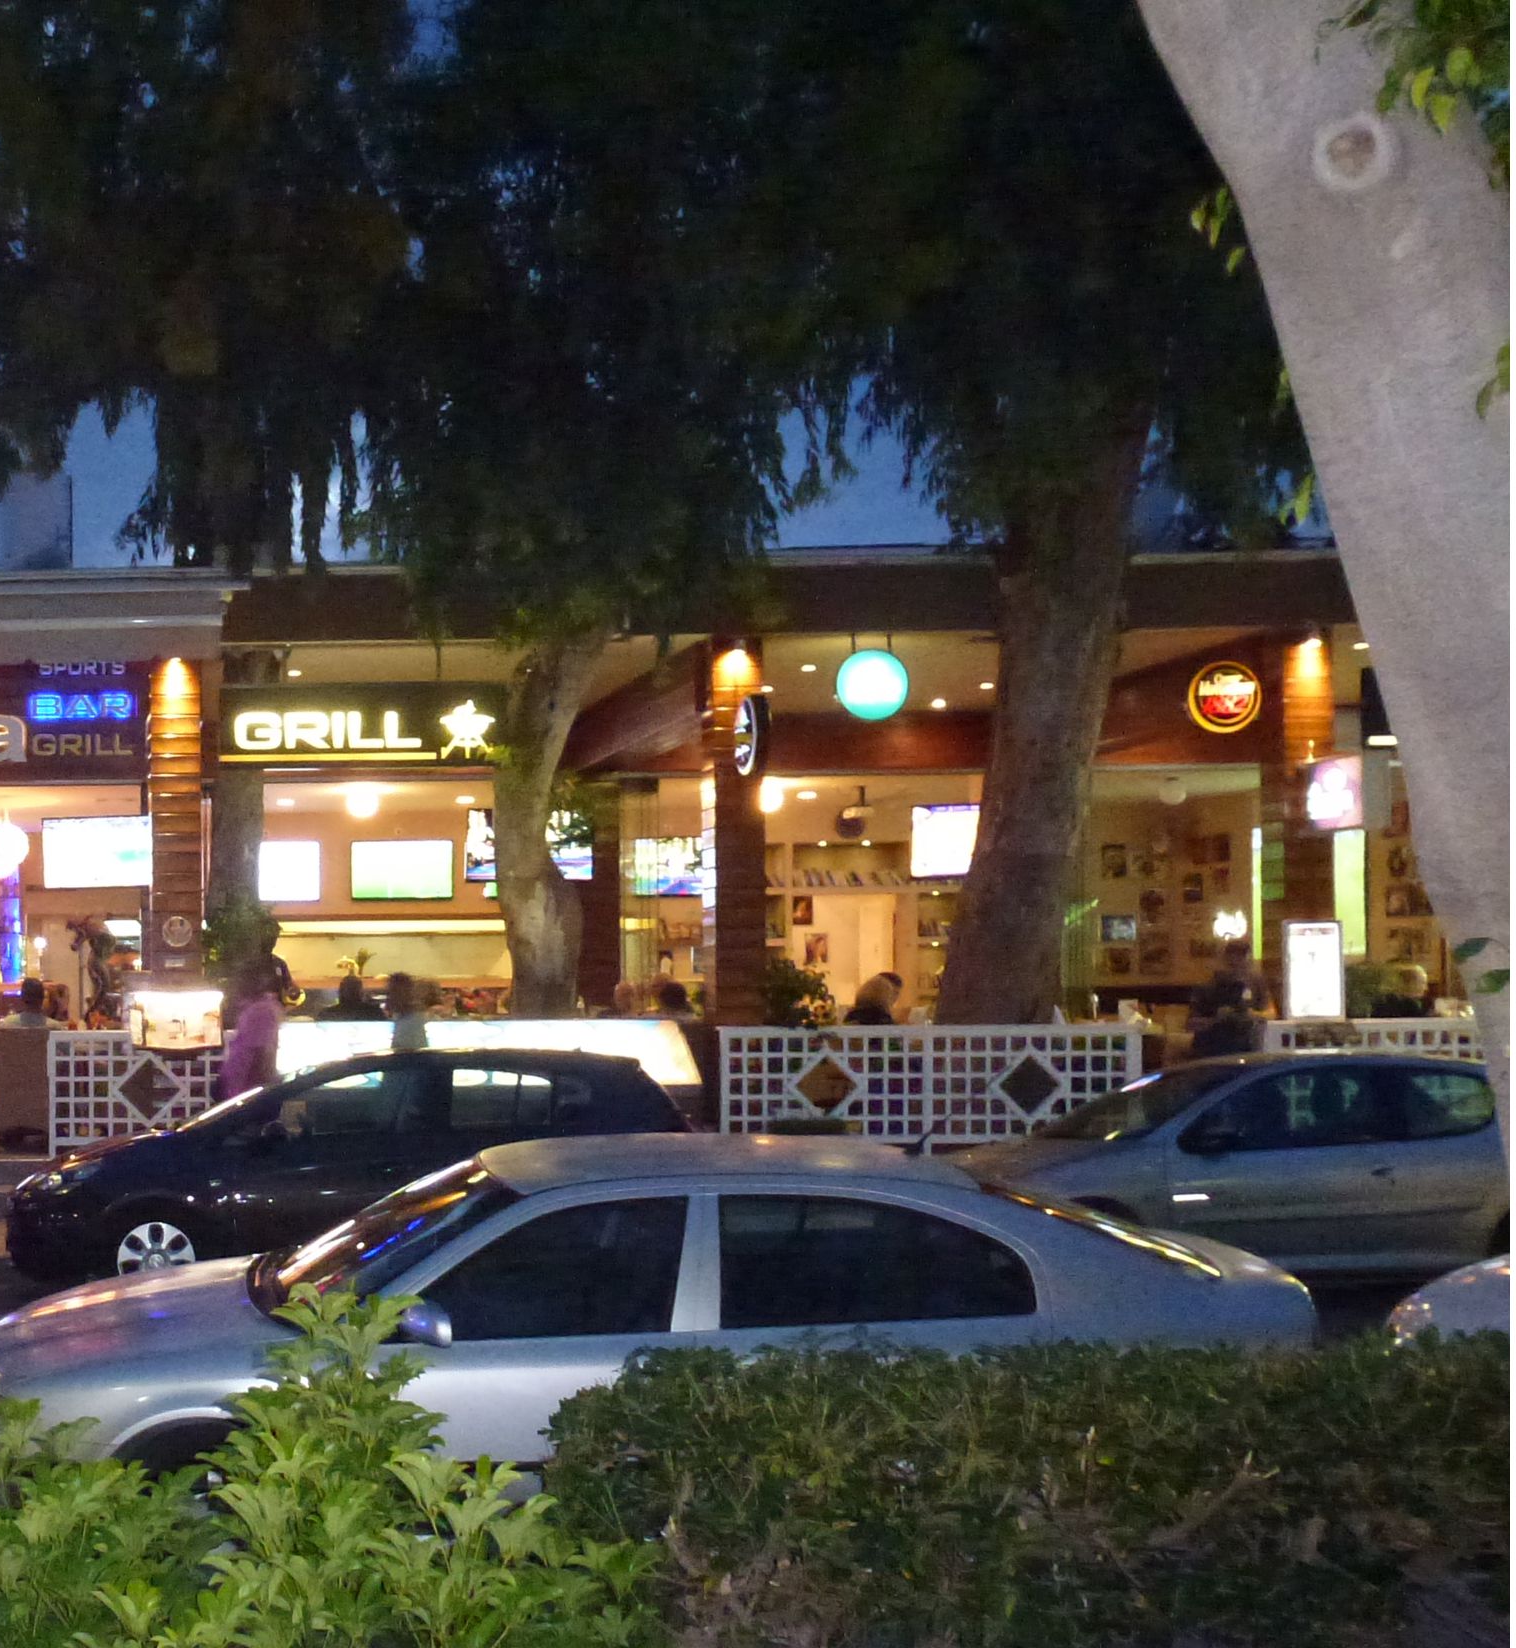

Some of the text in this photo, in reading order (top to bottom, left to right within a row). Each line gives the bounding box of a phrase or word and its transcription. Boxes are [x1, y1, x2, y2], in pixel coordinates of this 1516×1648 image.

[38, 660, 126, 676] SPORTS
[30, 692, 134, 719] BAR
[233, 710, 423, 750] GRILL
[33, 733, 133, 756] GRILL
